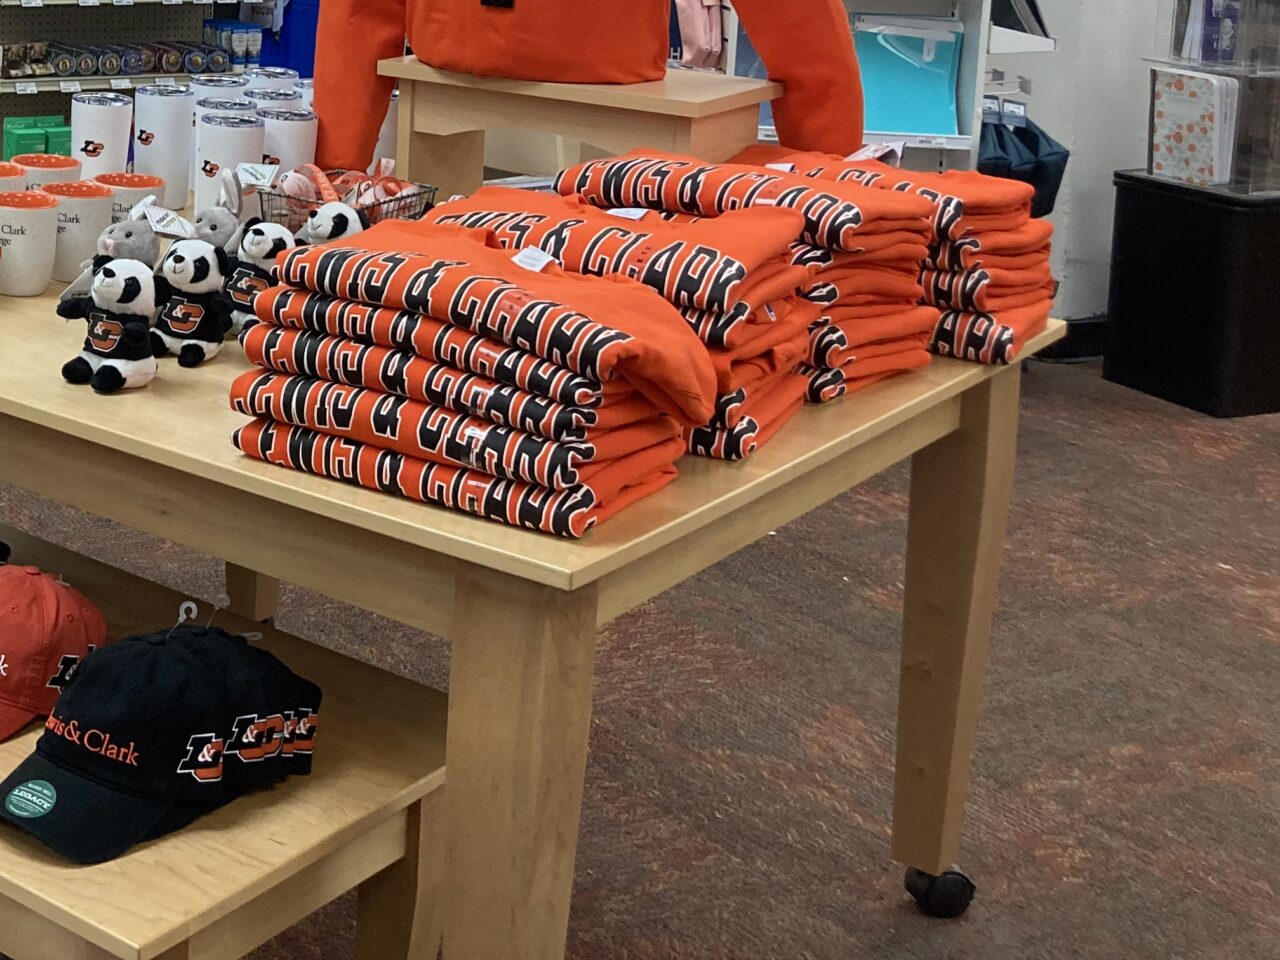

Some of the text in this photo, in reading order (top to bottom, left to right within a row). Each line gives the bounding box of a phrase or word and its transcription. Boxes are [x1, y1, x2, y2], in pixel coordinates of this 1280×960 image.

[57, 213, 81, 225] Clark
[1, 223, 27, 236] Clark
[64, 720, 81, 745] &
[83, 729, 140, 768] Clark
[13, 789, 51, 809] LEGACY
